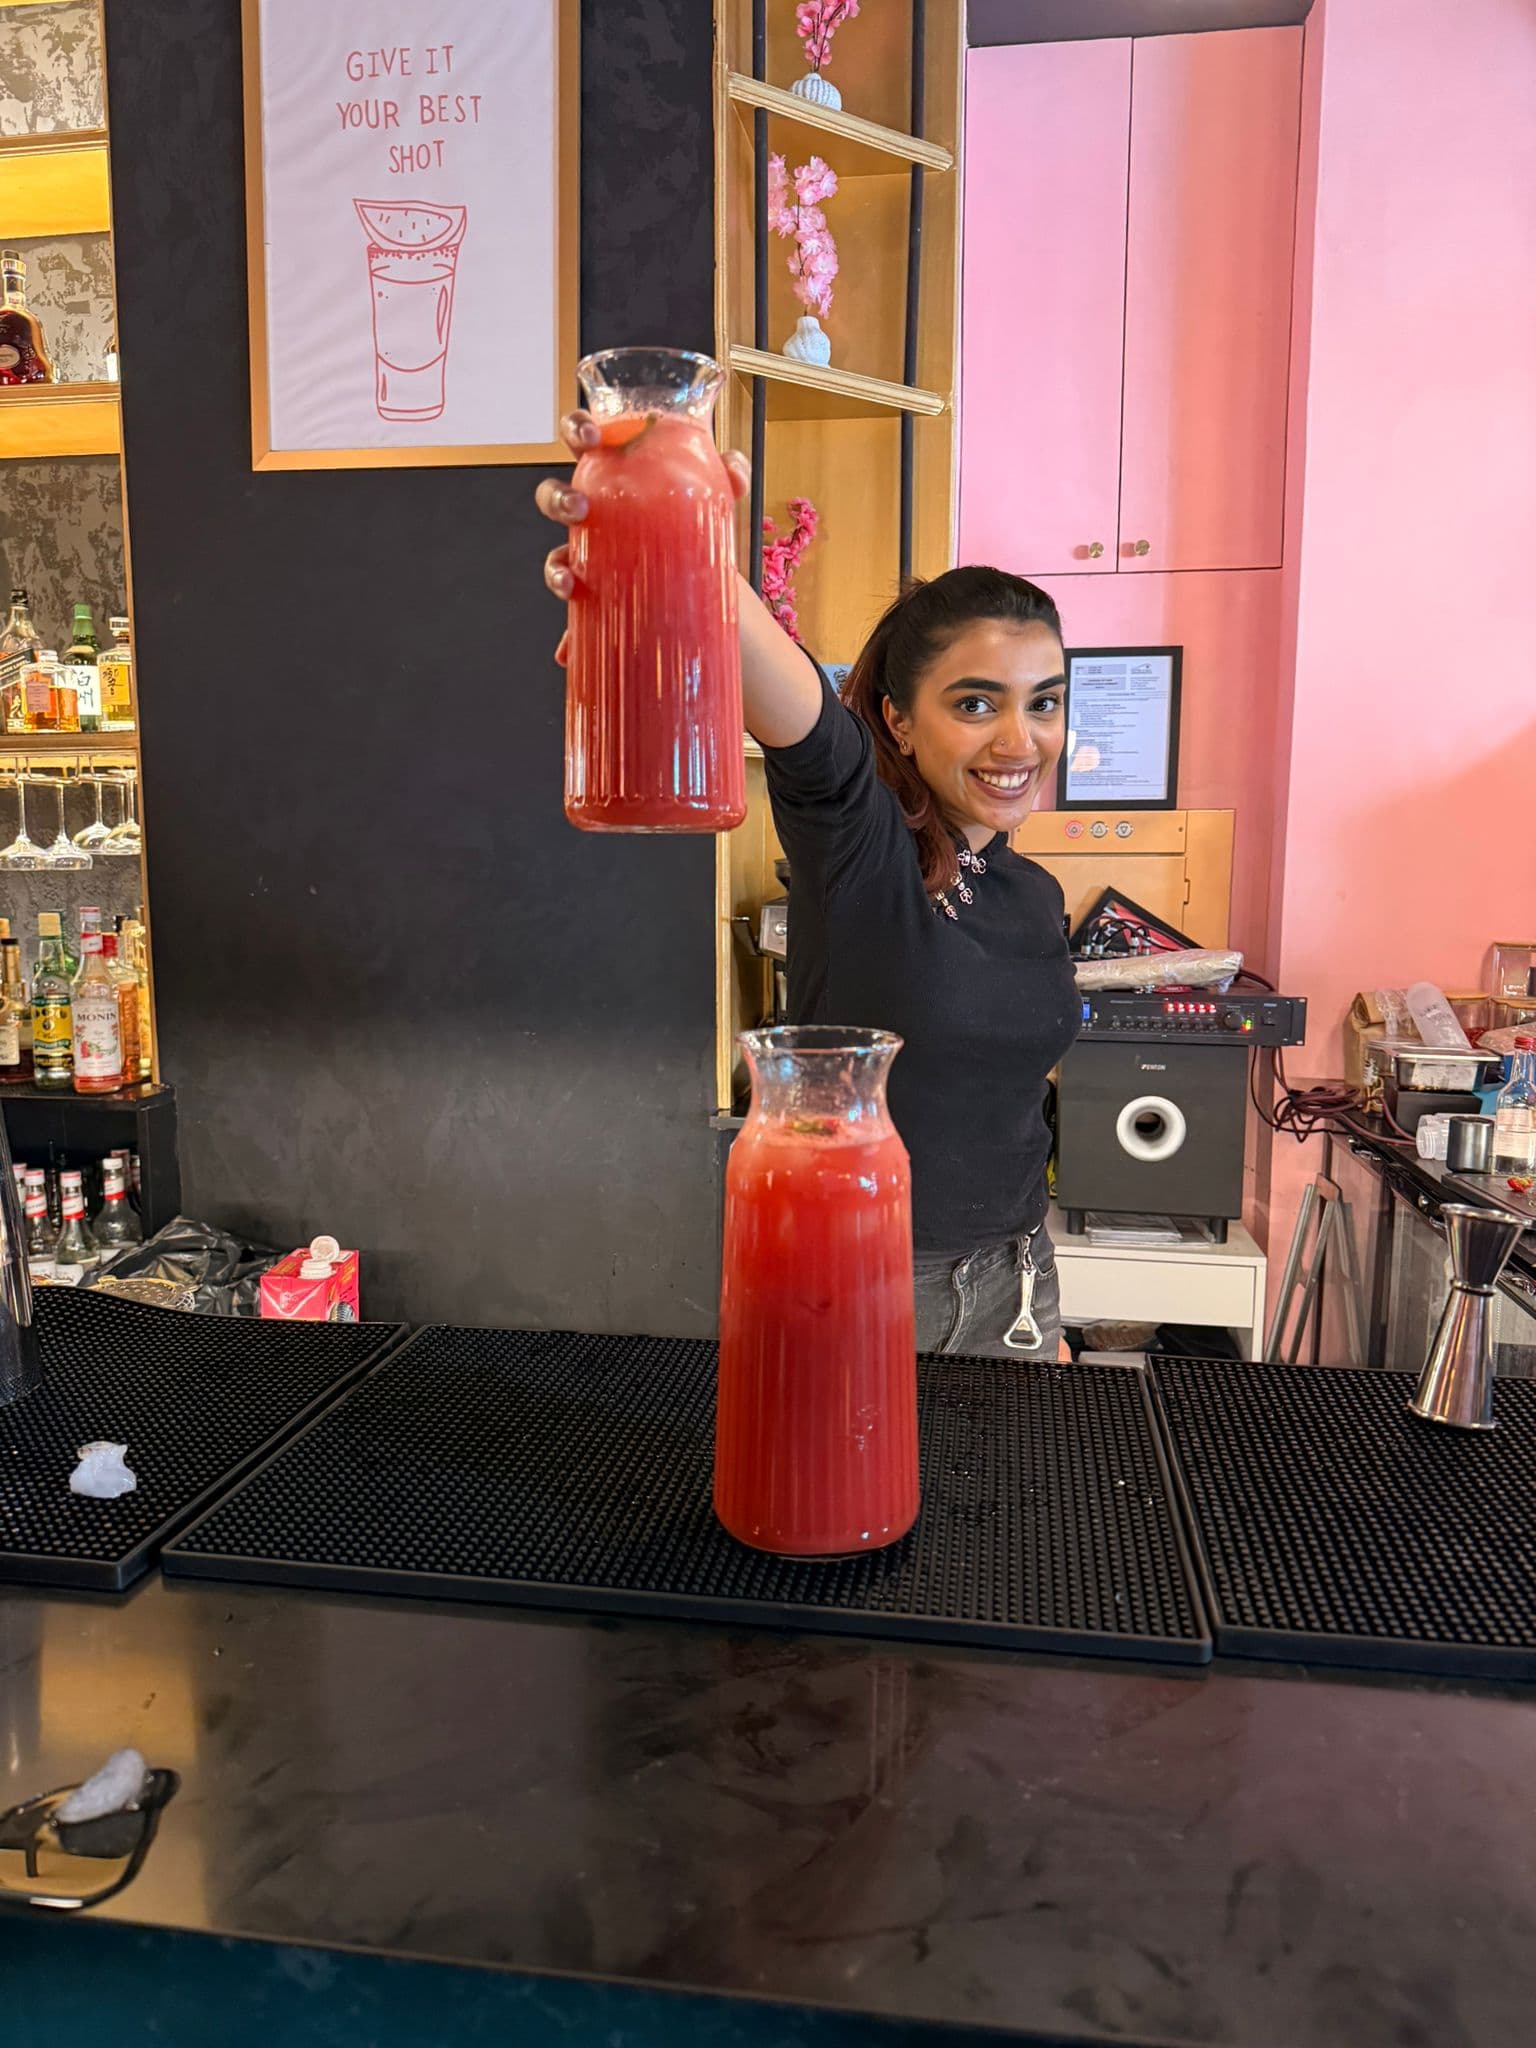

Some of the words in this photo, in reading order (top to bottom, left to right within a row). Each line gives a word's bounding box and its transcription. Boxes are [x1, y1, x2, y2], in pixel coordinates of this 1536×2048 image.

[346, 47, 412, 82] GIVE
[425, 45, 454, 74] IT
[336, 99, 400, 130] YOUR
[419, 94, 482, 125] BEST
[388, 140, 445, 174] SHOT
[77, 1012, 117, 1021] MONIN
